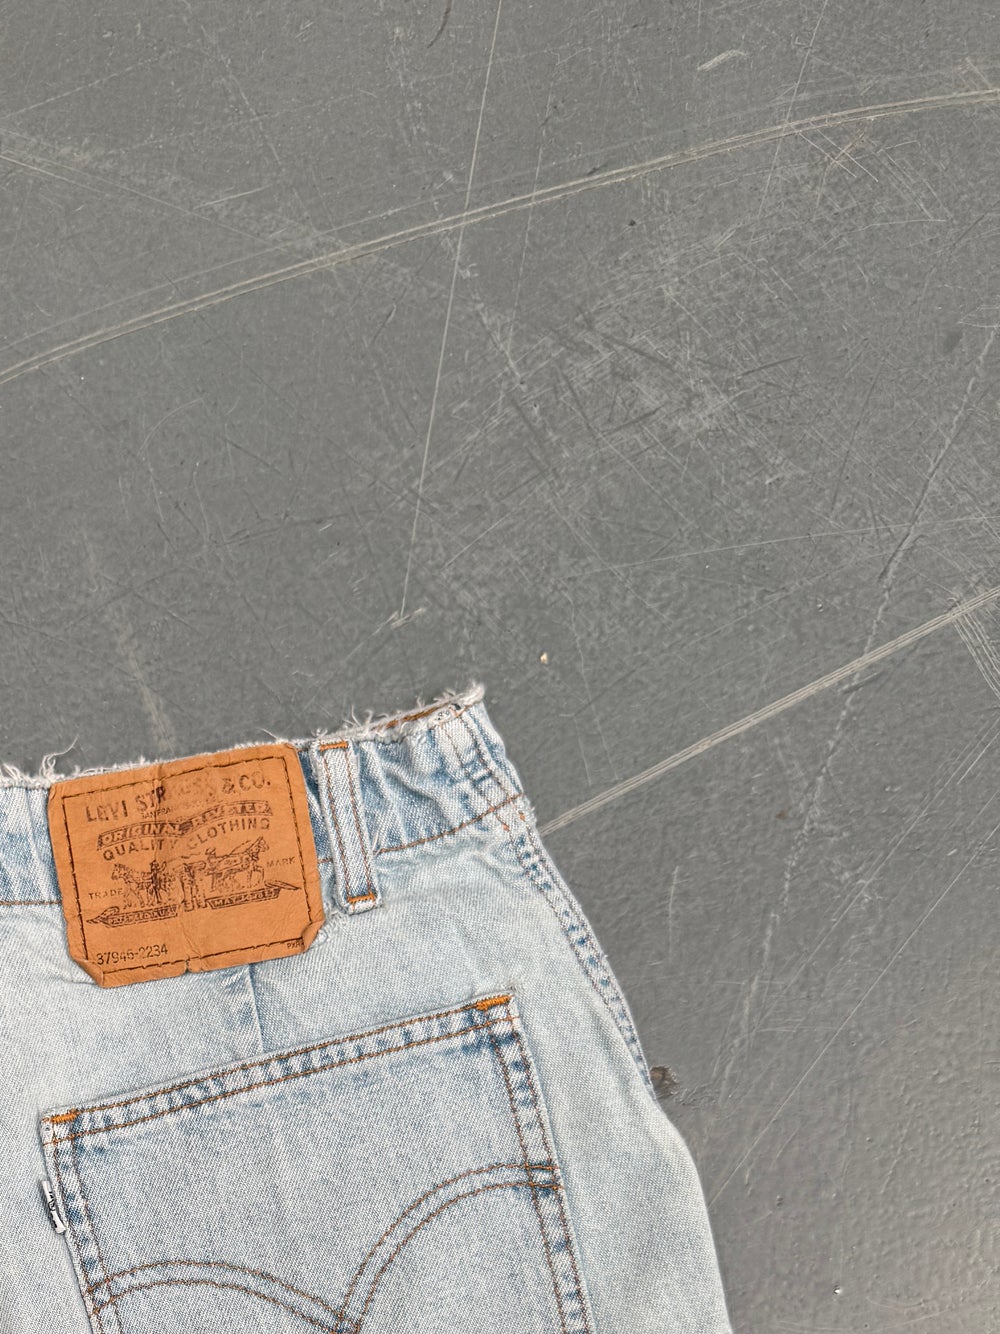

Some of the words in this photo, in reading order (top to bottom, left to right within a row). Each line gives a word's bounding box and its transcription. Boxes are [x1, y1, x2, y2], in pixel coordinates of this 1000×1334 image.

[101, 822, 184, 844] ORIGINAL
[102, 838, 178, 861] QUALITY
[186, 817, 271, 850] CLOTHING
[266, 856, 296, 868] MARK
